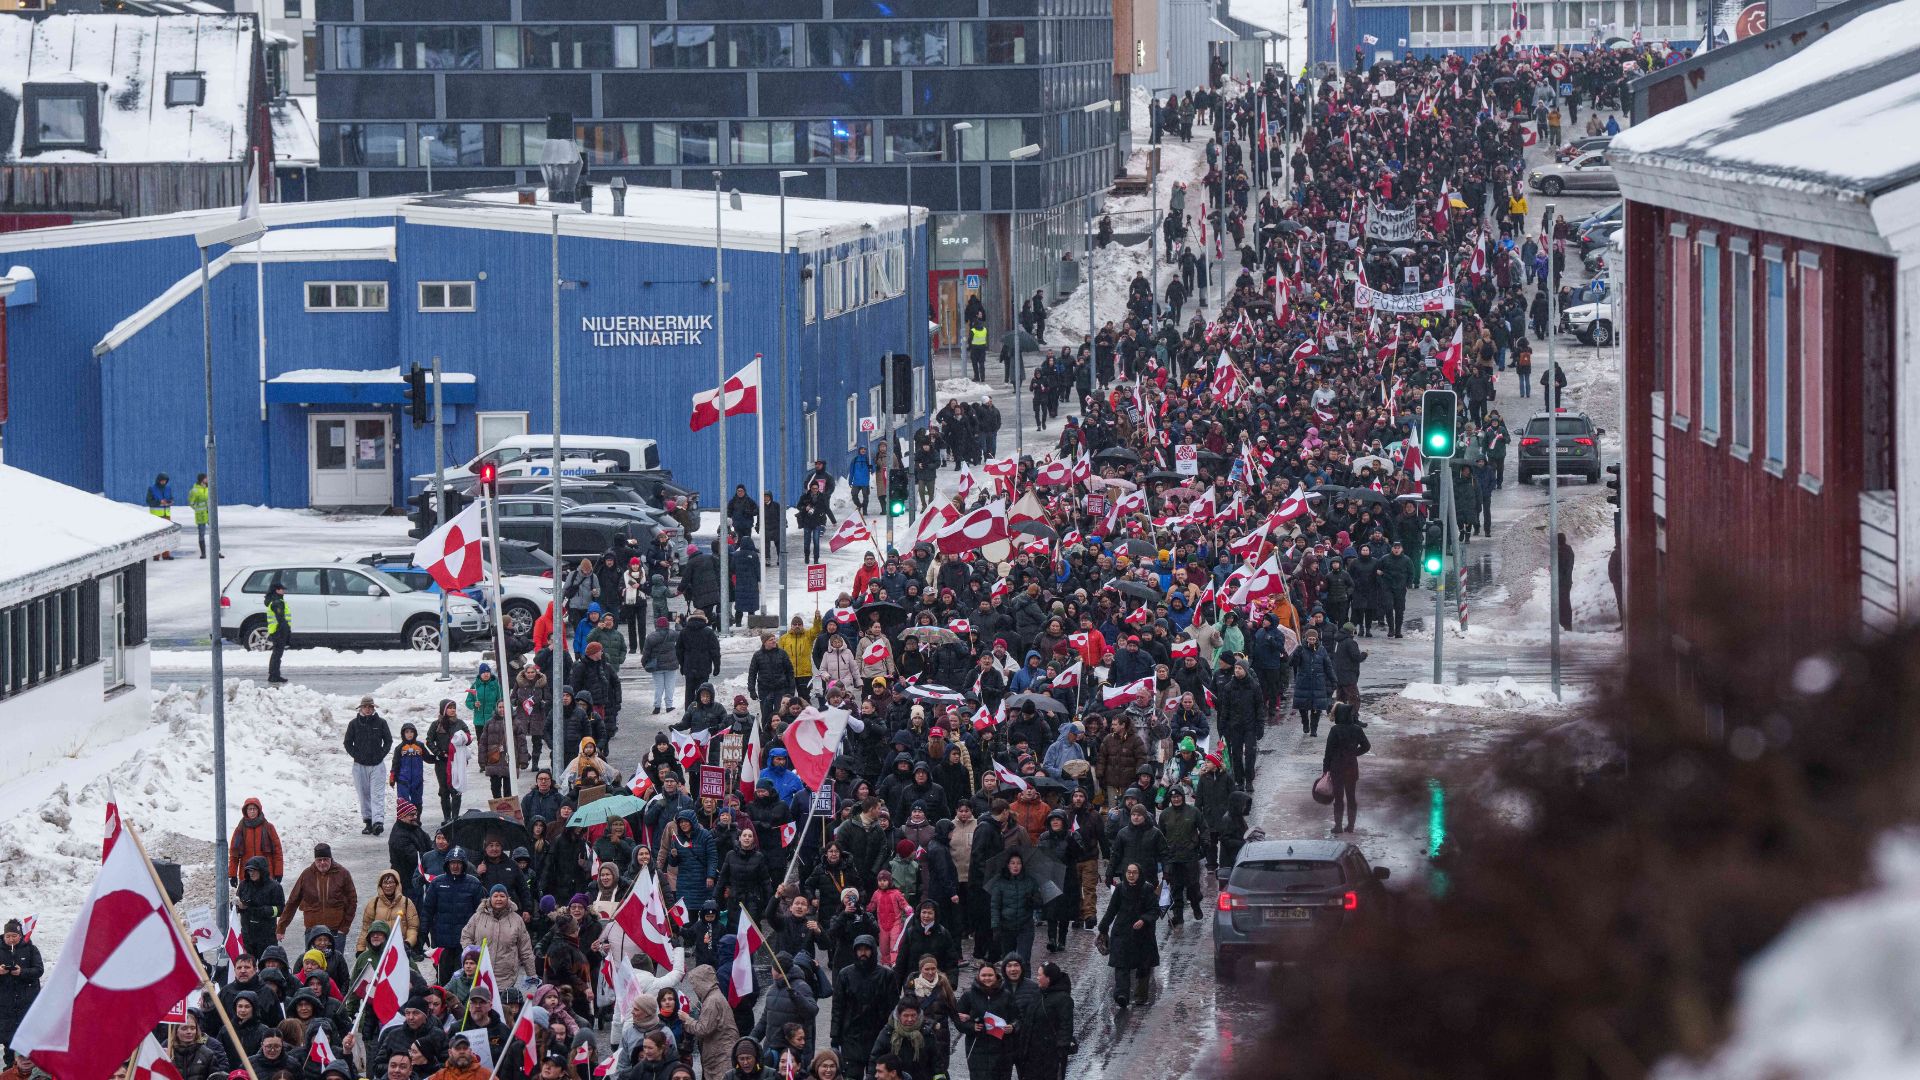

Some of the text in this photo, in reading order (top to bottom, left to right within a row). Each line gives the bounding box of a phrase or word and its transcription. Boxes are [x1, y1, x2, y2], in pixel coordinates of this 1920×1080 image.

[1370, 221, 1388, 236] GO
[942, 237, 969, 245] SPAR
[1431, 285, 1454, 299] OUR
[1372, 299, 1422, 312] FUTURE
[582, 315, 713, 331] NIUERNERMIK
[593, 330, 702, 347] ILINNIARFIK
[703, 784, 722, 794] SALE!
